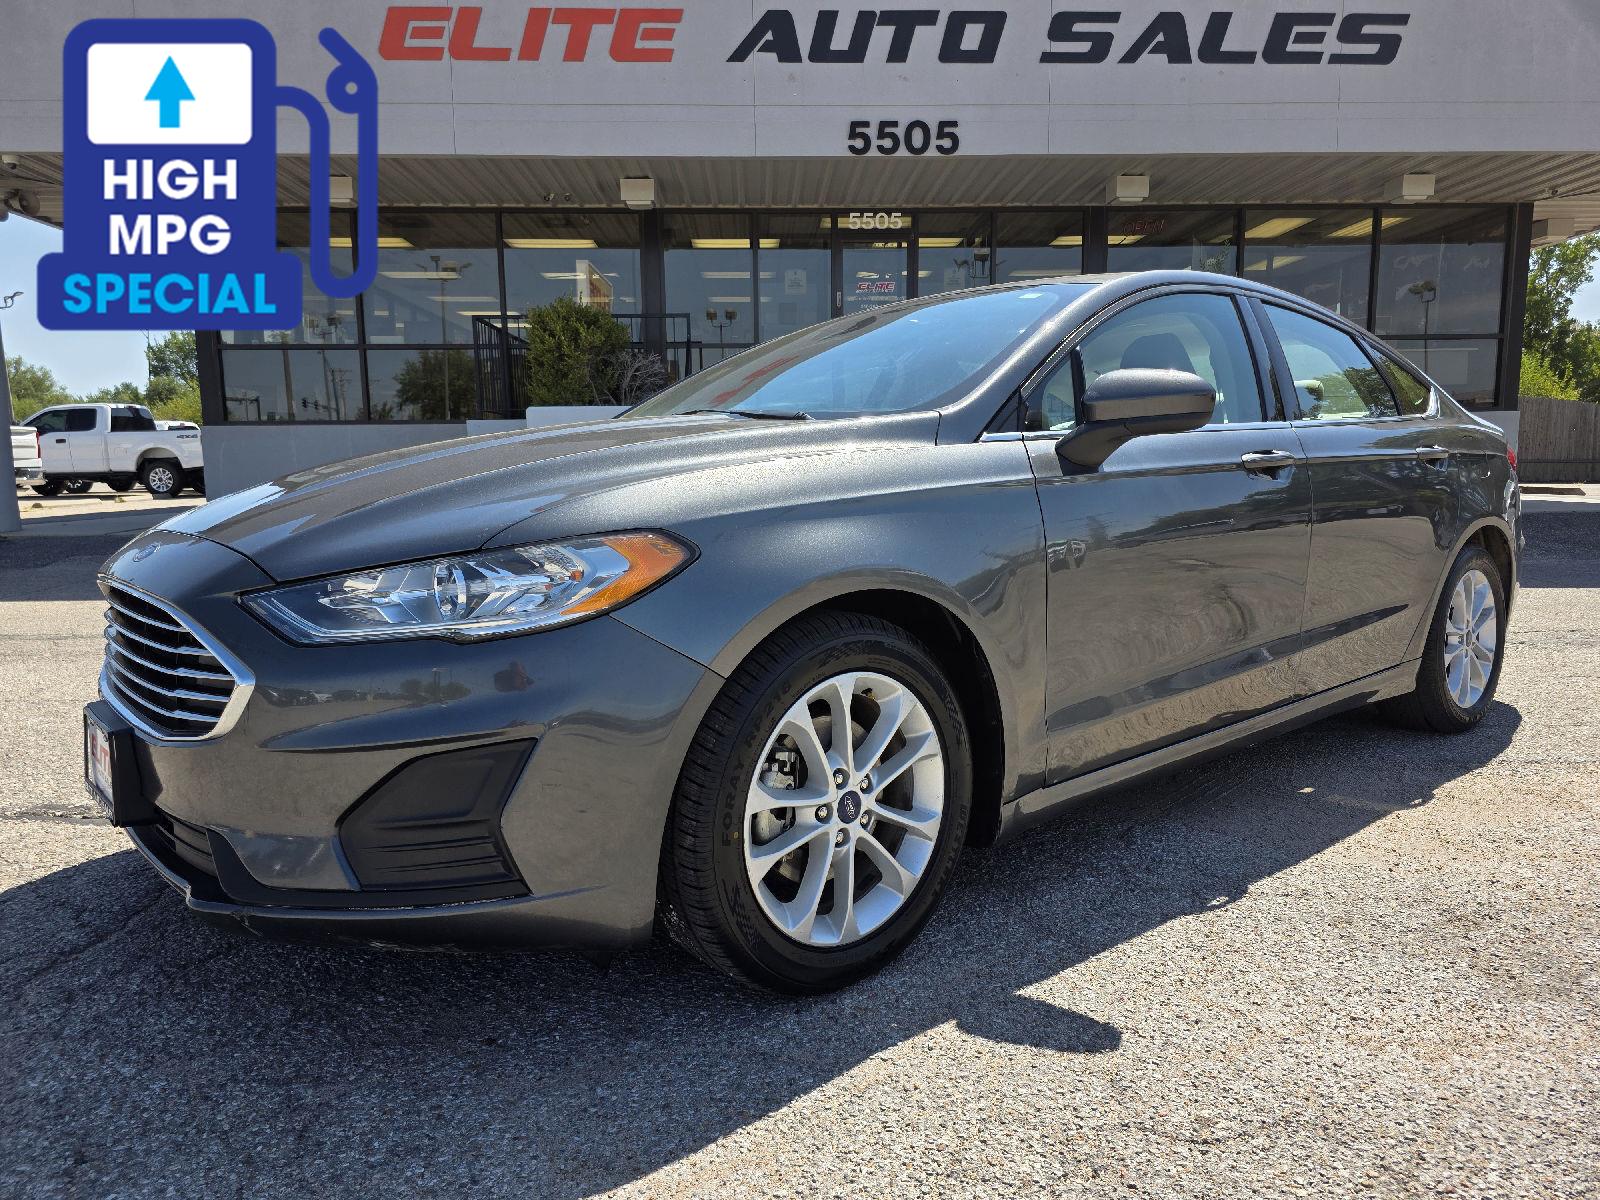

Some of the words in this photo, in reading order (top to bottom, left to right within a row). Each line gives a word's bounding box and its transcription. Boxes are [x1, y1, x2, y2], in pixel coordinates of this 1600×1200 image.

[378, 6, 684, 63] ELITE
[725, 9, 1007, 64] AUTO
[1039, 10, 1411, 66] SALES
[847, 119, 960, 156] 5505
[849, 212, 903, 230] 5505
[856, 281, 896, 292] ELITE
